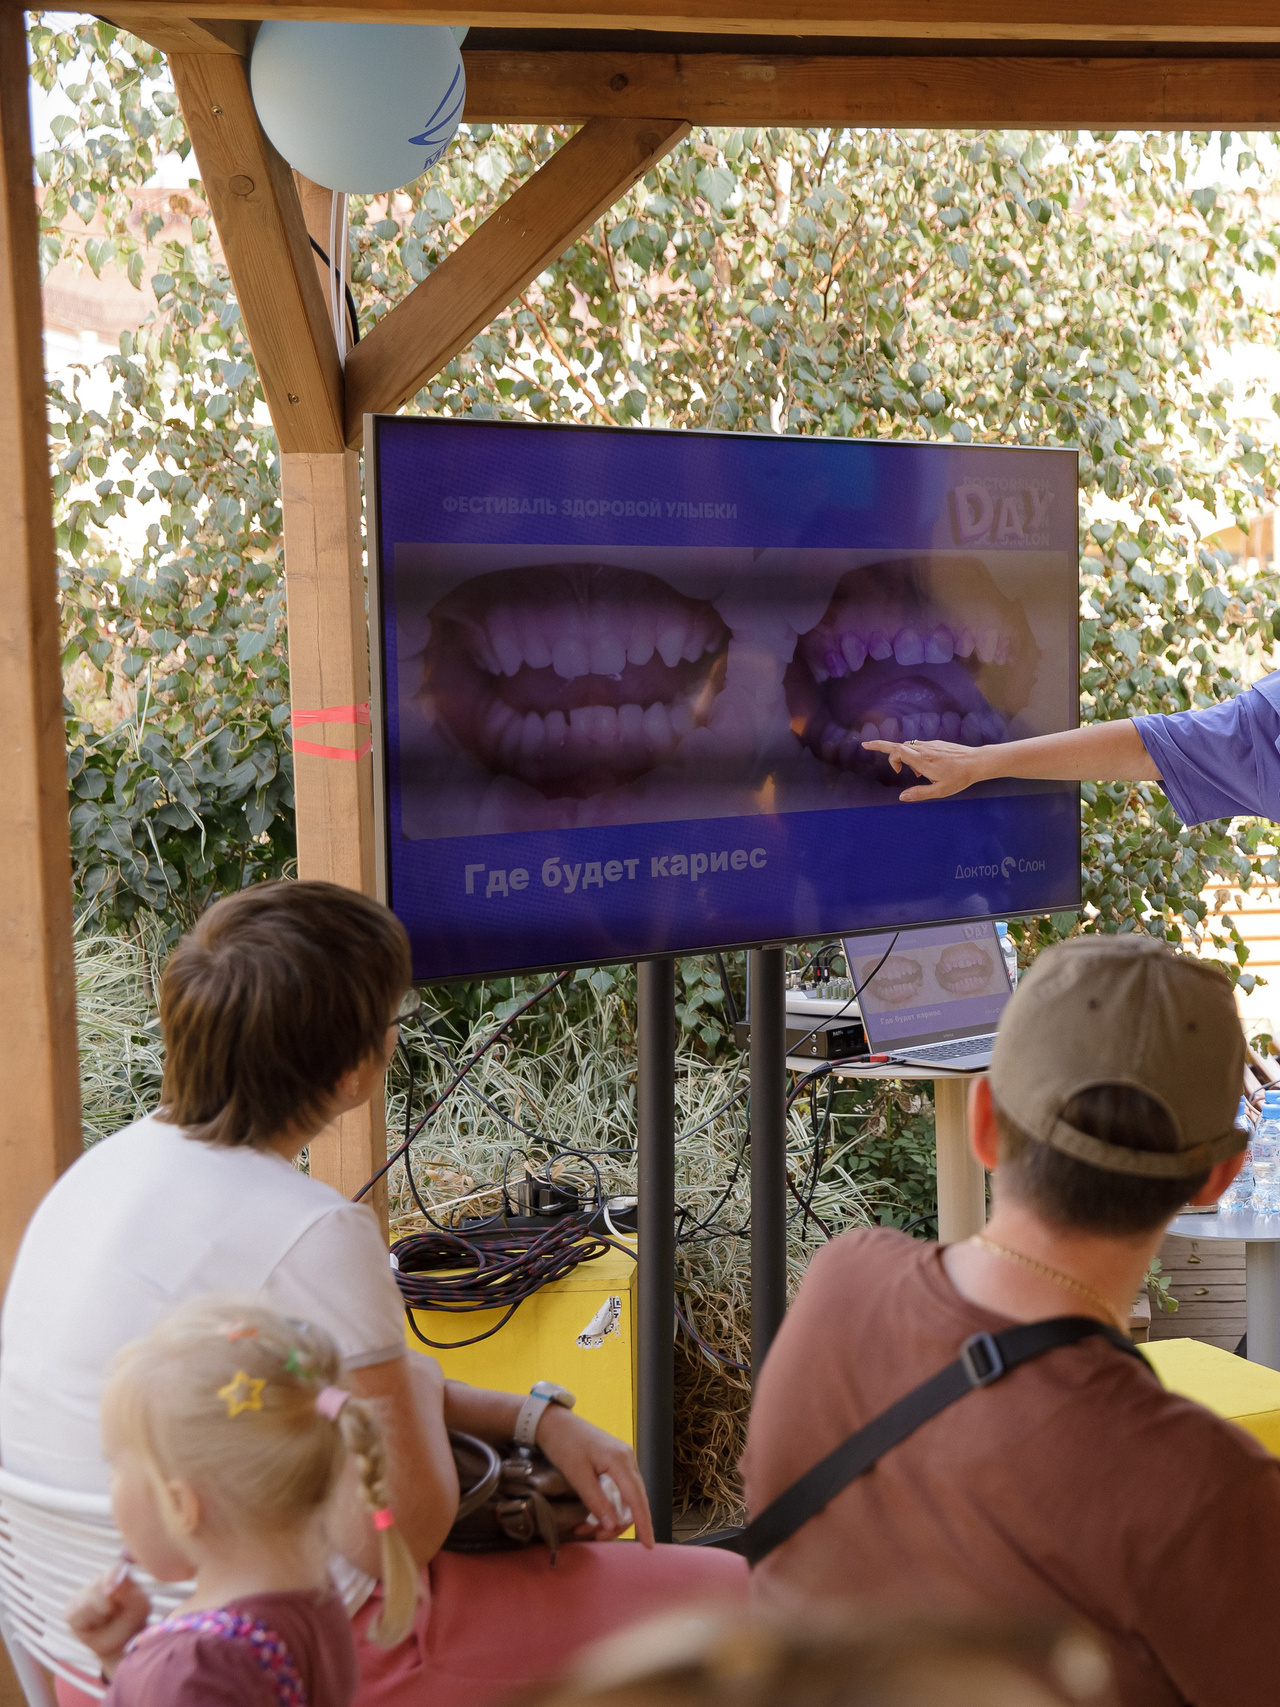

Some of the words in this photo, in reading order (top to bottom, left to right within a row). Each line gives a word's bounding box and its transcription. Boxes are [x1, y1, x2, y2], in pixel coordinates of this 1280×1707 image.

[442, 496, 557, 515] ФЕСТИВАЛЬ
[561, 498, 662, 518] ЗДОРОВОЙ
[666, 502, 738, 519] УЛЫБКИ
[948, 483, 1056, 544] DAY
[465, 864, 530, 898] Где
[541, 857, 640, 894] будет
[651, 848, 767, 881] кариес
[955, 864, 999, 879] Доктор
[1018, 859, 1046, 872] Слон
